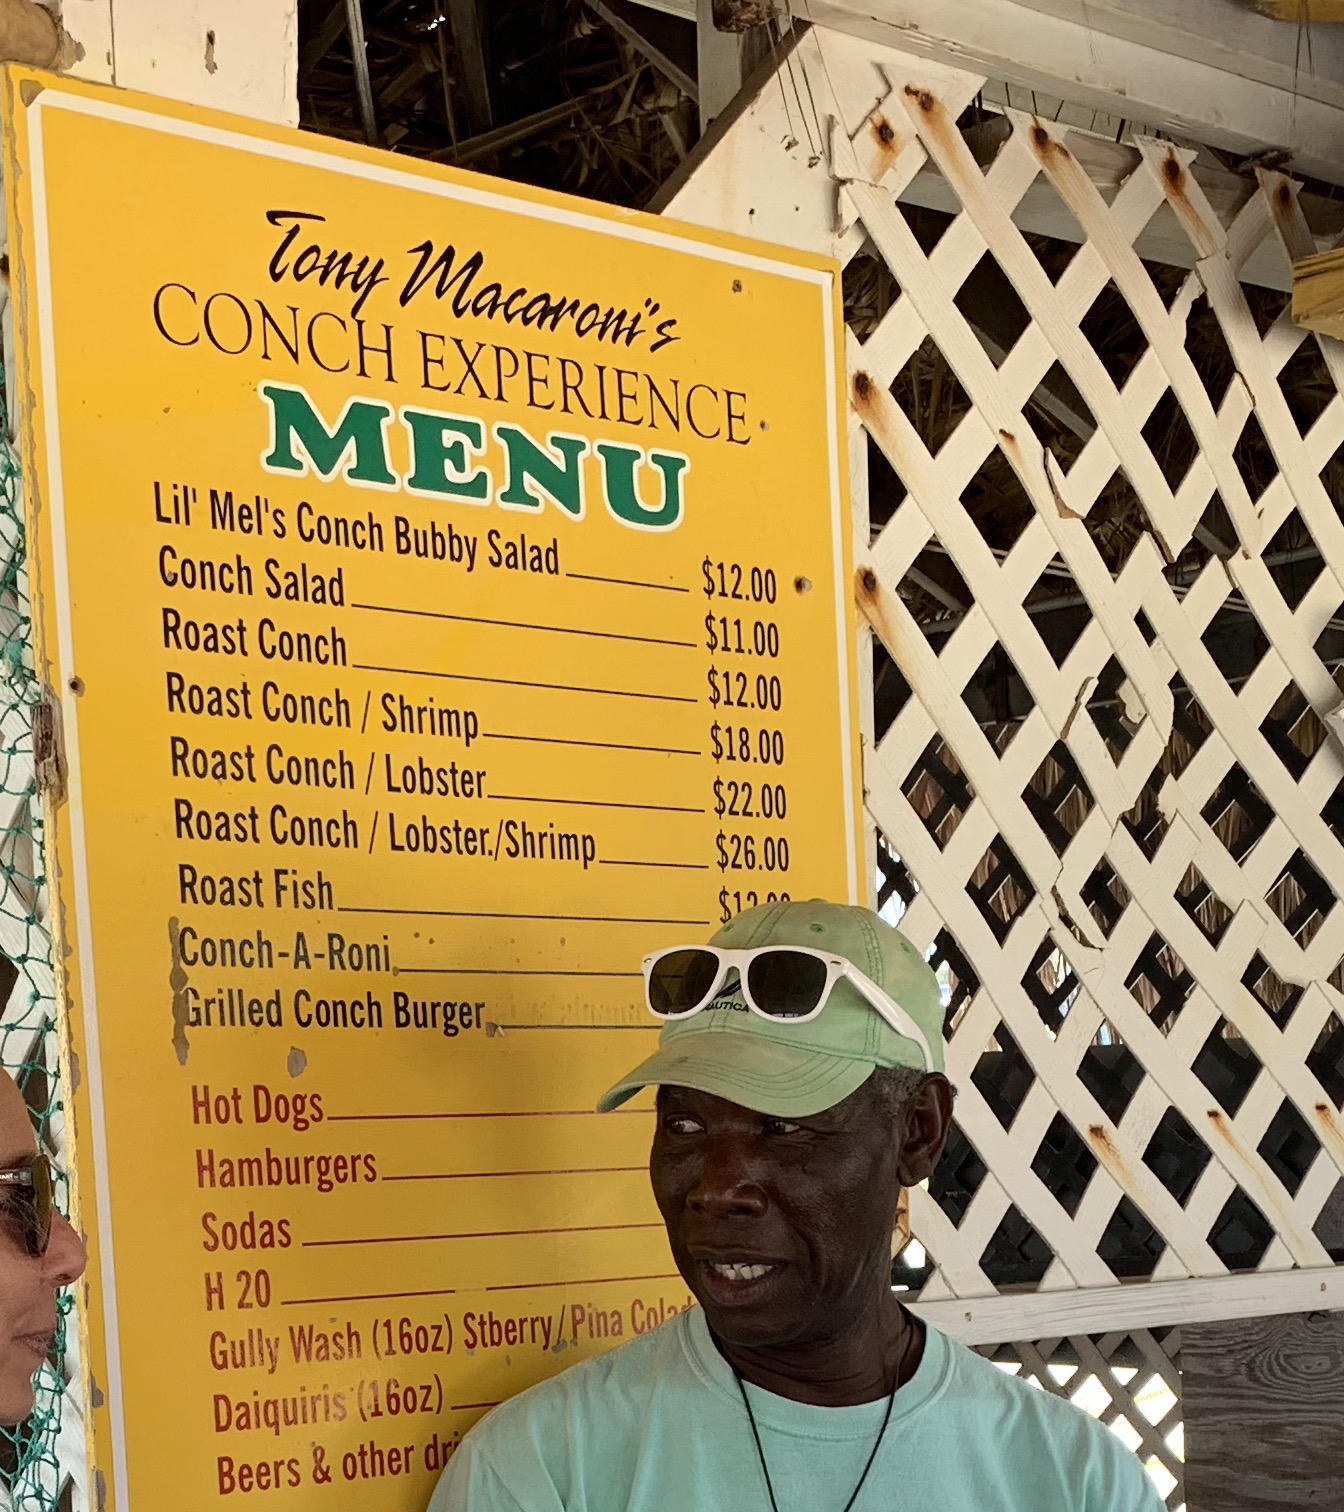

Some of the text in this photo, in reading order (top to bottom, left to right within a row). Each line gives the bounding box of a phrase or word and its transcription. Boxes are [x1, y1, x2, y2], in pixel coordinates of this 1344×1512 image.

[265, 210, 681, 353] Tony Macaroni's
[153, 282, 753, 447] CONCH EXPERIENCE
[261, 385, 689, 528] MENU
[153, 480, 777, 605] Lil' Mel's Conch Bubby Salad $12.00
[158, 544, 780, 658] Conch Salad $11.00
[161, 607, 782, 712] Roast Conch $12.00
[165, 671, 784, 766] Roast Conch / Shrimp $18.00
[170, 735, 787, 821] Roast Conch / Lobster $22.00
[174, 797, 261, 844] Roast
[269, 803, 359, 849] Conch
[368, 810, 379, 855] /
[715, 828, 790, 874] $26.00
[178, 862, 266, 911] Roast
[273, 867, 336, 914] Fish
[179, 926, 393, 974] Conch-A-Roni
[182, 987, 284, 1030] Grilled
[293, 988, 383, 1029] Conch
[394, 992, 486, 1037] Burger
[704, 1001, 750, 1013] AUTICA
[191, 1084, 324, 1132] Hot Dogs
[195, 1147, 378, 1193] Hamburgers
[201, 1210, 292, 1252] Sodas
[204, 1271, 225, 1312] H
[209, 1329, 280, 1374] Gully
[289, 1322, 362, 1365] Wash
[372, 1313, 453, 1358] (16oz)
[213, 1374, 444, 1436] Daiquiris (16oz)
[217, 1455, 301, 1496] Beers
[312, 1445, 332, 1485] &
[342, 1439, 415, 1481] other
